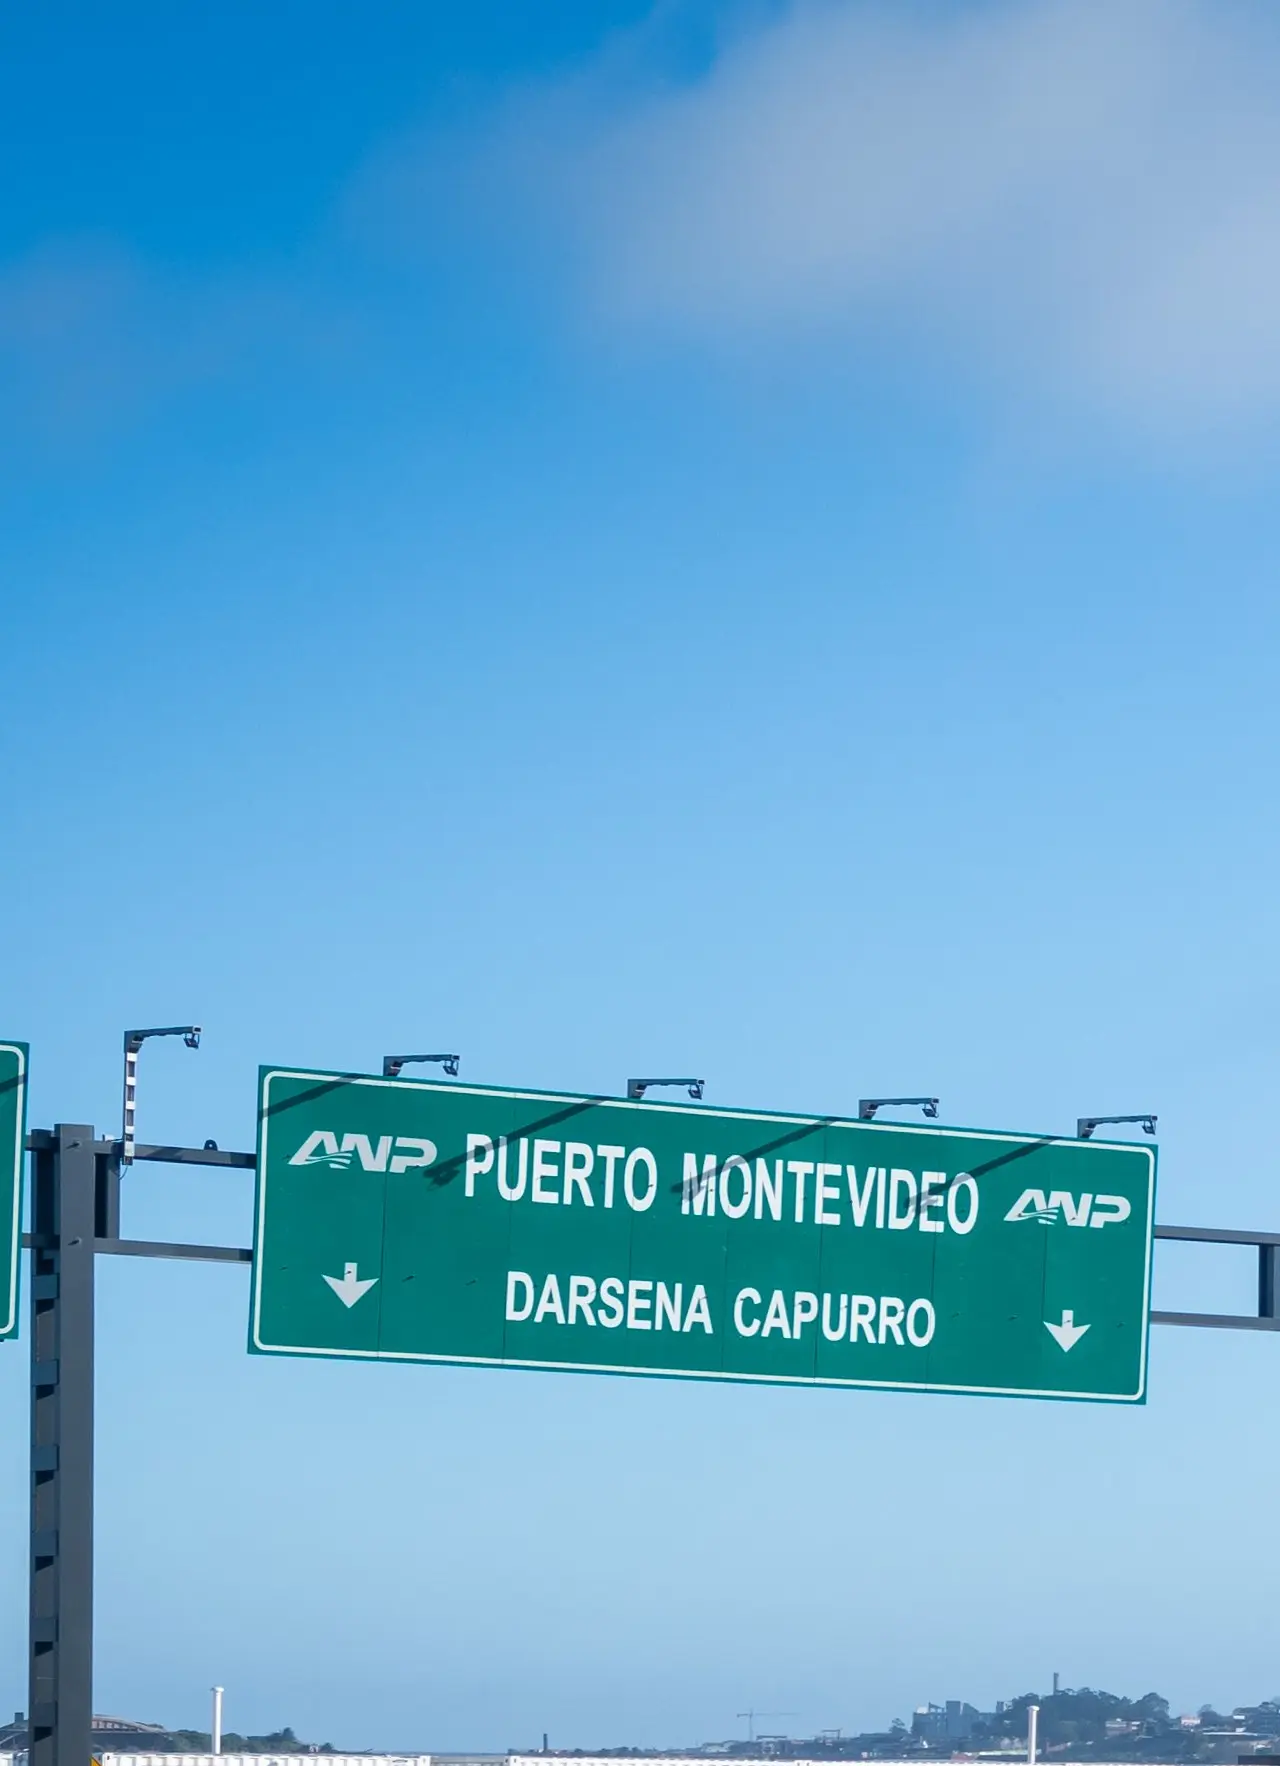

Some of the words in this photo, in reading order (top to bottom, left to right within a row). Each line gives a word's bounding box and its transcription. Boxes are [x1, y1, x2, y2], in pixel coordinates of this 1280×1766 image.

[288, 1130, 438, 1174] ANP
[464, 1133, 658, 1212] PUERTO
[681, 1152, 979, 1236] MONTEVIDEO
[1003, 1188, 1131, 1229] ANP
[505, 1270, 714, 1334] DARSENA
[733, 1287, 936, 1348] CAPURRO
